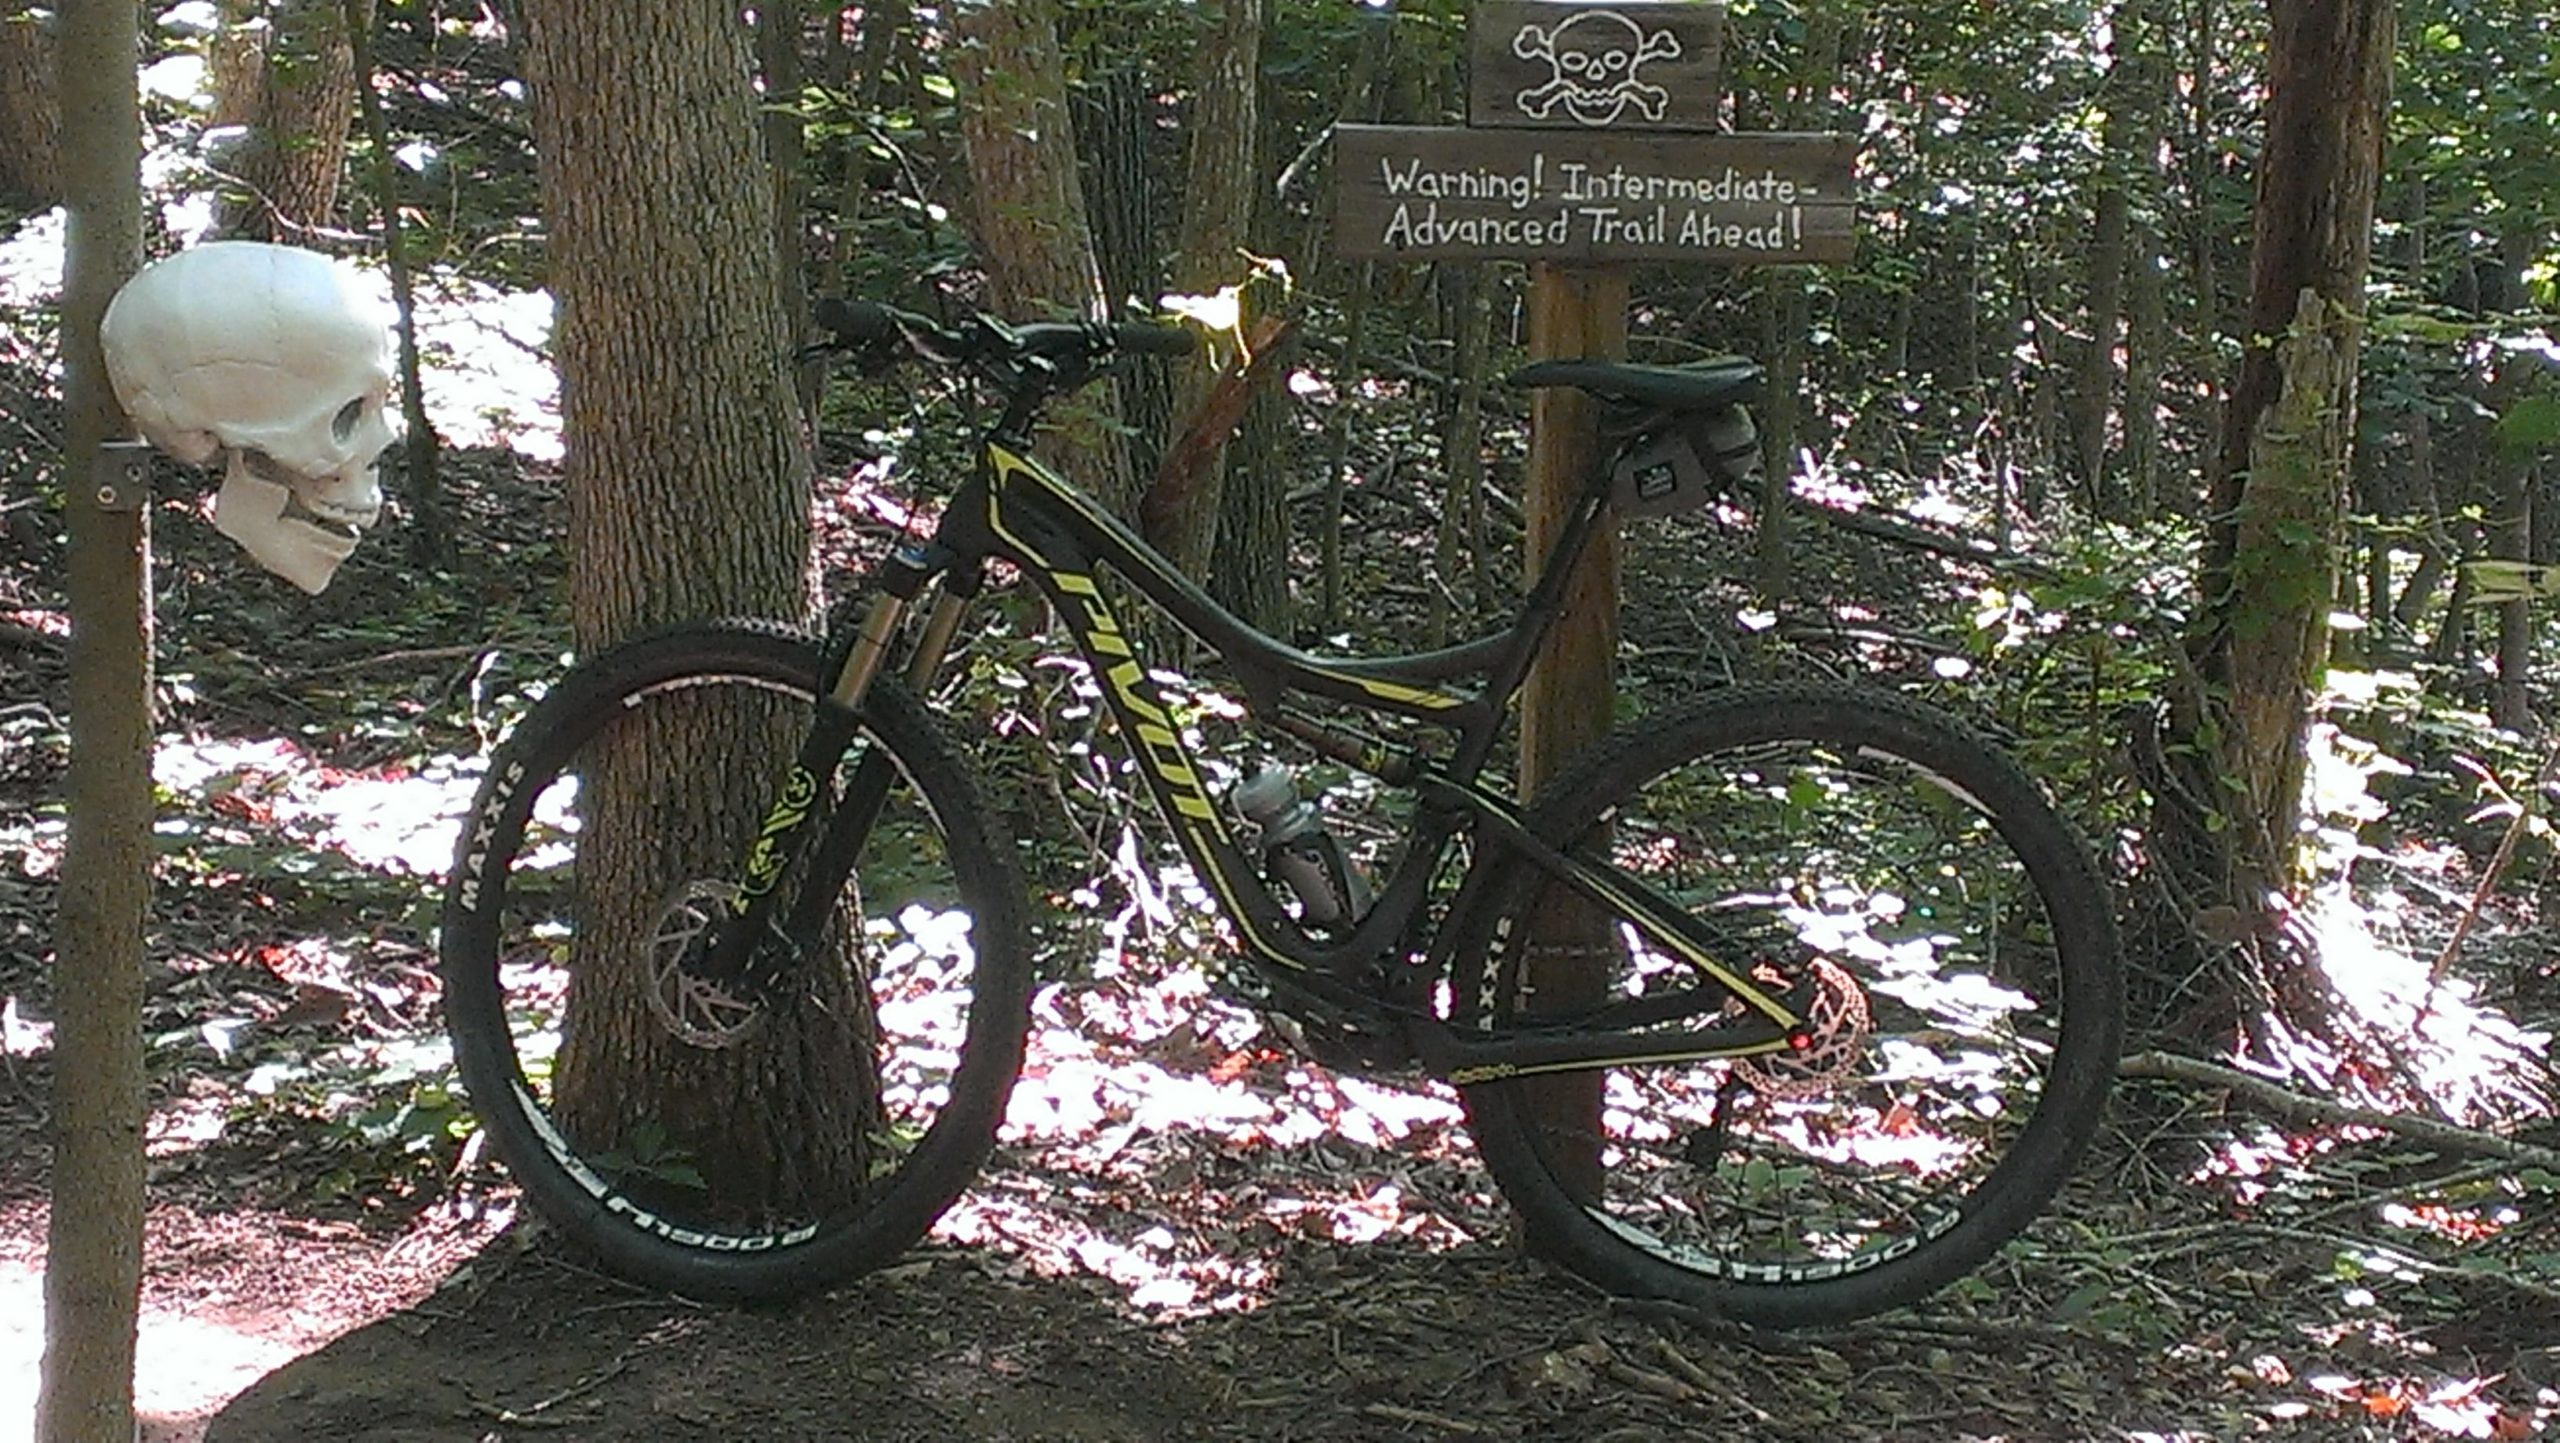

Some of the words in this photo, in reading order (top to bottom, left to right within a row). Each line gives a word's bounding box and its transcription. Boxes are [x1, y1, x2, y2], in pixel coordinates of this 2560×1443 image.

[1381, 152, 1544, 210] Warning!
[1559, 162, 1819, 204] Intermediate-
[1382, 204, 1569, 247] Advanced
[1578, 206, 1666, 244] Trail
[1677, 206, 1802, 252] Ahead!
[1050, 571, 1230, 846] PIVOT
[460, 760, 526, 912] MAXXIS
[1478, 916, 1513, 1032] AXXIS
